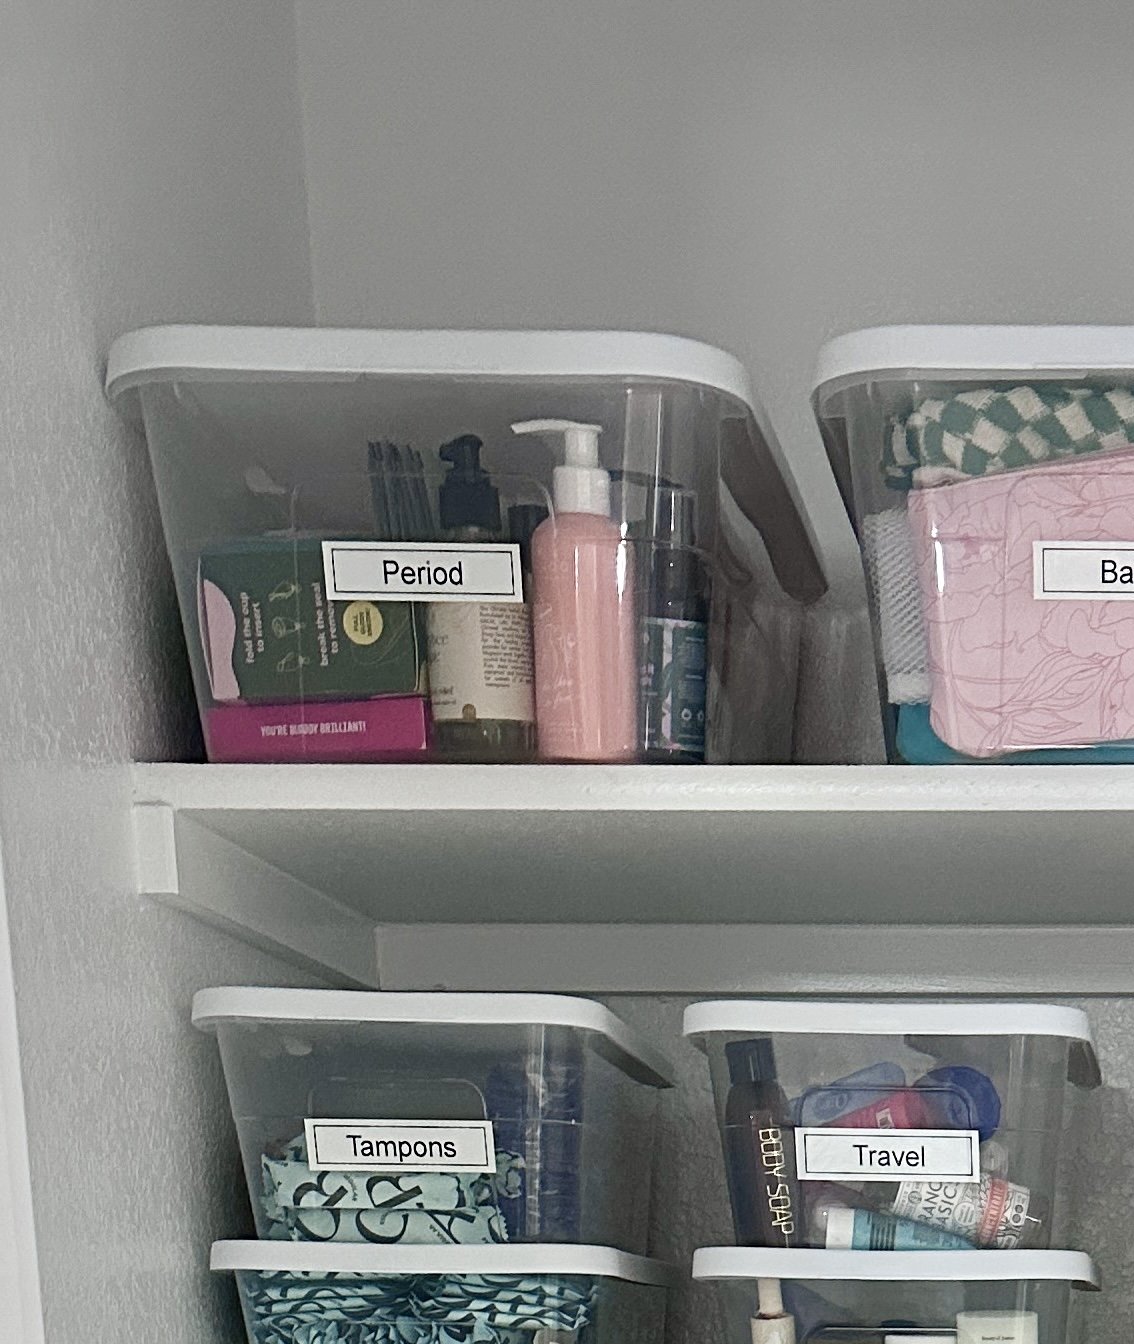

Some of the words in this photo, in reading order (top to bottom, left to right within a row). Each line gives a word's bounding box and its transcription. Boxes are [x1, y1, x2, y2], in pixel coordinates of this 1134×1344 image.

[383, 560, 463, 585] Period
[346, 1135, 456, 1162] Tampons
[853, 1145, 924, 1166] Travel
